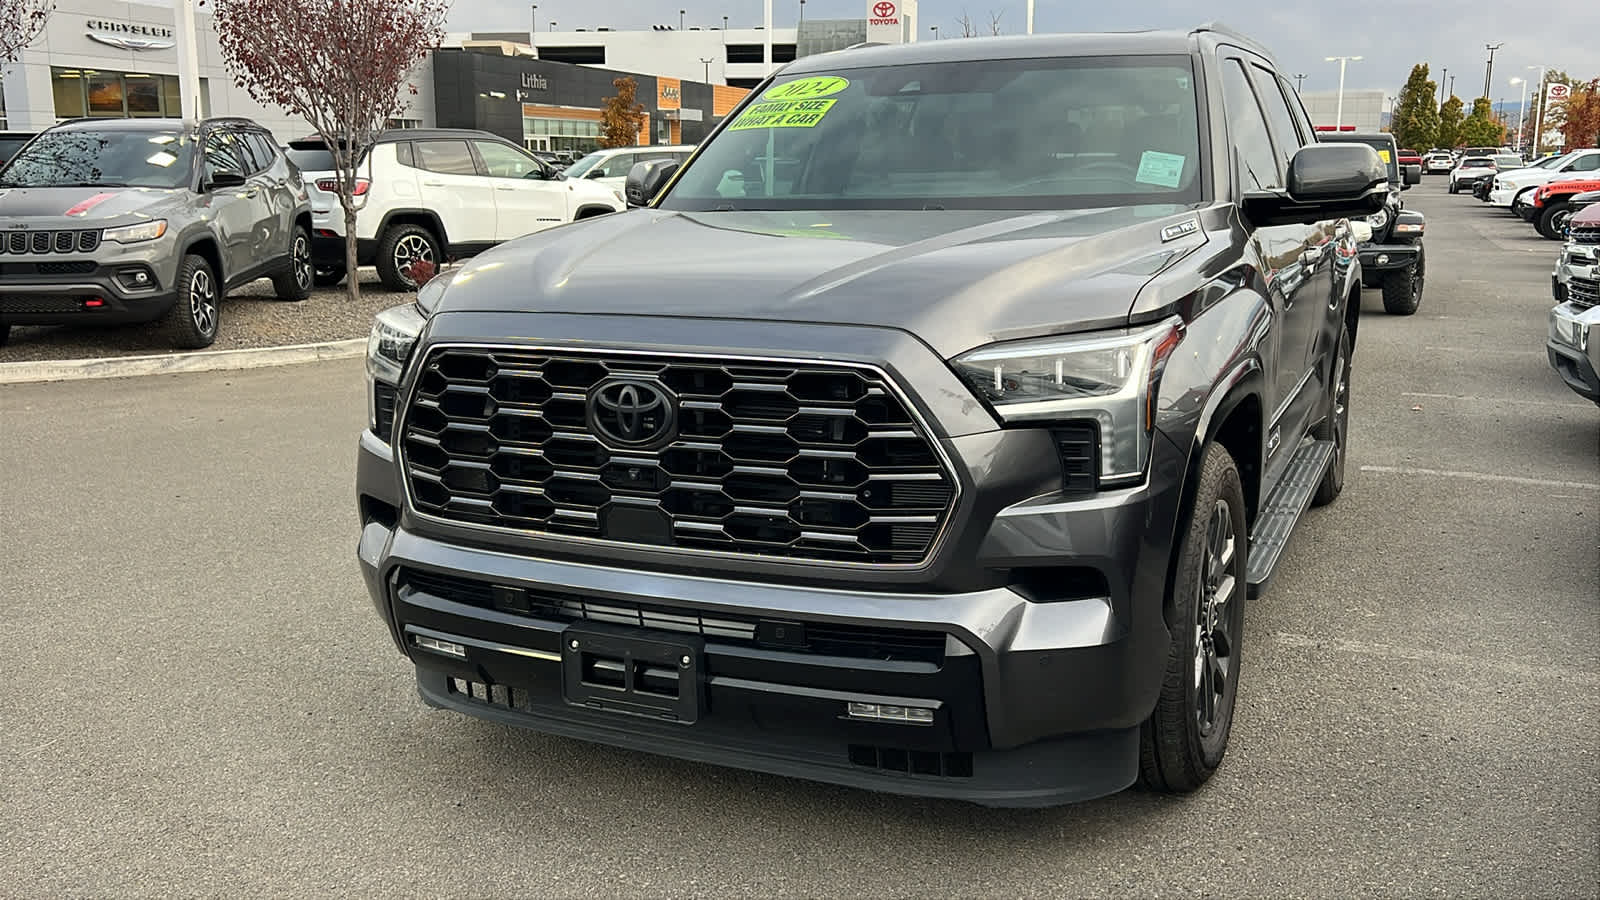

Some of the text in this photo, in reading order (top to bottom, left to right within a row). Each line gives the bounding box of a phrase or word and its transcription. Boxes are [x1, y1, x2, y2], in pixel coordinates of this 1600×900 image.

[86, 20, 172, 37] CHRYSLER
[869, 18, 899, 26] TOYOTA
[521, 72, 547, 89] Lithia
[770, 80, 841, 98] 2024
[749, 100, 829, 115] FAMILY SIZE
[733, 113, 821, 128] WHAT A CAR
